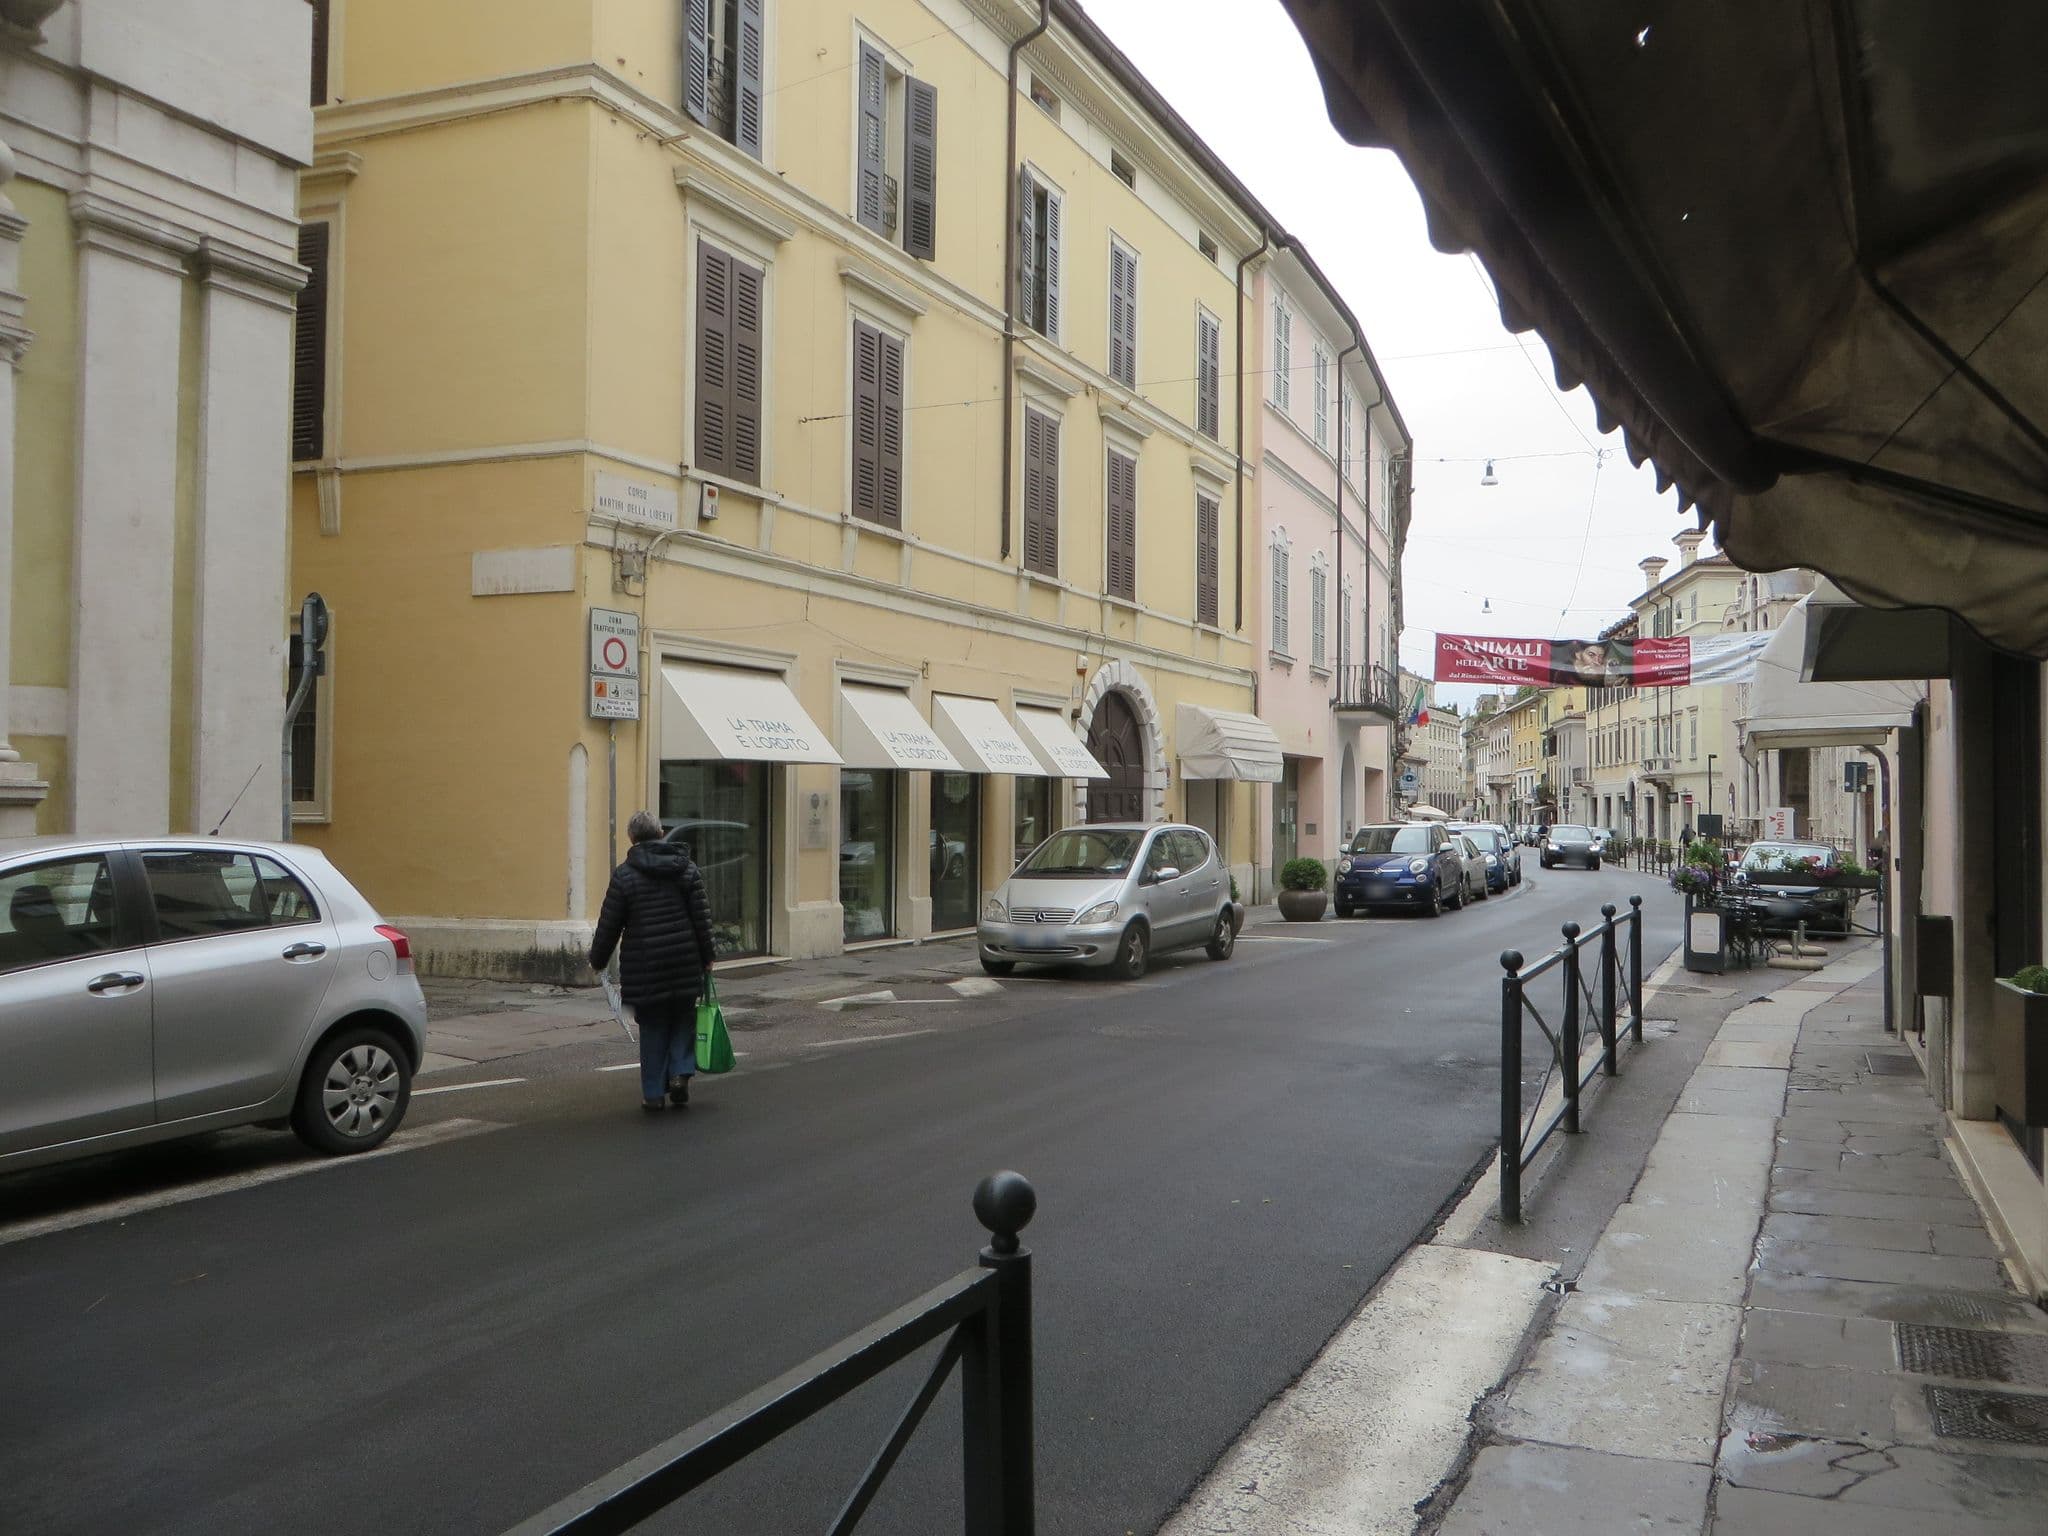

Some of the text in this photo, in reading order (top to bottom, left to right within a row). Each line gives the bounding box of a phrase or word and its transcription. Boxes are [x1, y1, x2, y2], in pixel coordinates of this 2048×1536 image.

[627, 485, 648, 500] CORSO
[627, 503, 646, 516] DELLA
[608, 615, 622, 625] ZONA
[593, 623, 636, 637] TRAFFICO LIMITATO
[1462, 639, 1543, 657] ANIMALI
[1455, 655, 1528, 672] NELL'ARTE
[726, 717, 796, 734] LA TRAMA
[735, 734, 810, 751] E L'ORDITO
[882, 731, 935, 747] LA TRAMA
[891, 746, 905, 759] E
